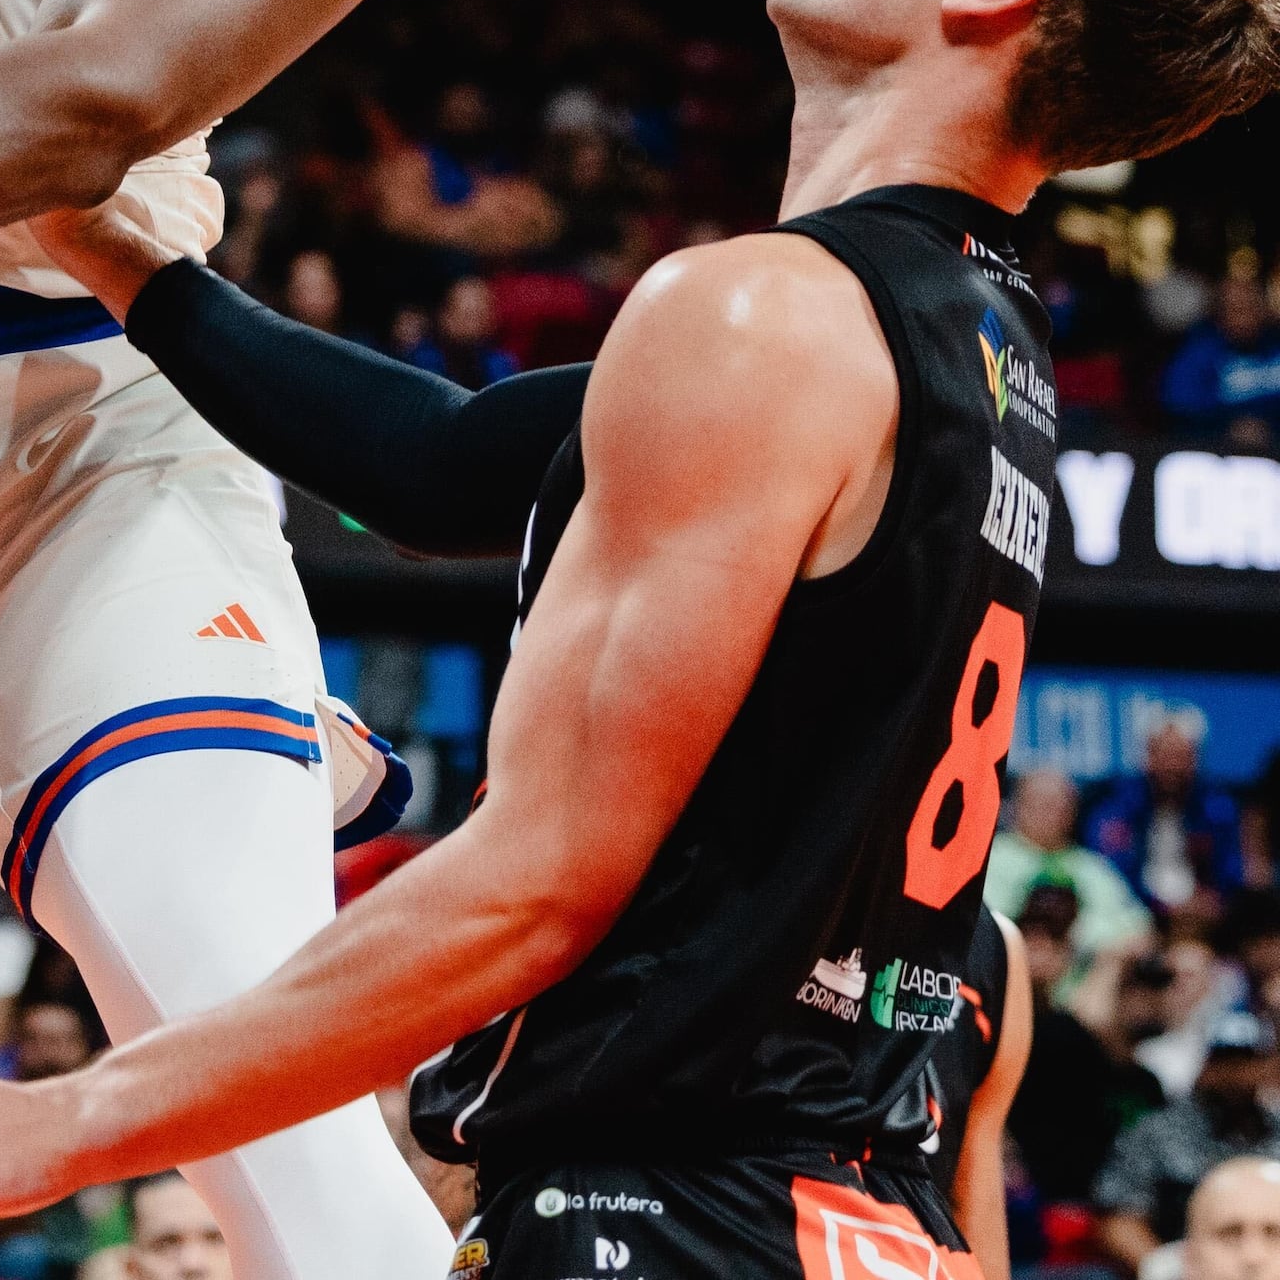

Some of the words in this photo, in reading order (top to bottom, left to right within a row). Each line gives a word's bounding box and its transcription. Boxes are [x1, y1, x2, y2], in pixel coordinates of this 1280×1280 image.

[983, 268, 1002, 283] SAN
[1006, 344, 1027, 393] SAN
[1027, 360, 1056, 418] RAFAEL
[903, 600, 1026, 911] 8
[567, 1192, 584, 1210] la
[589, 1192, 664, 1215] frutera
